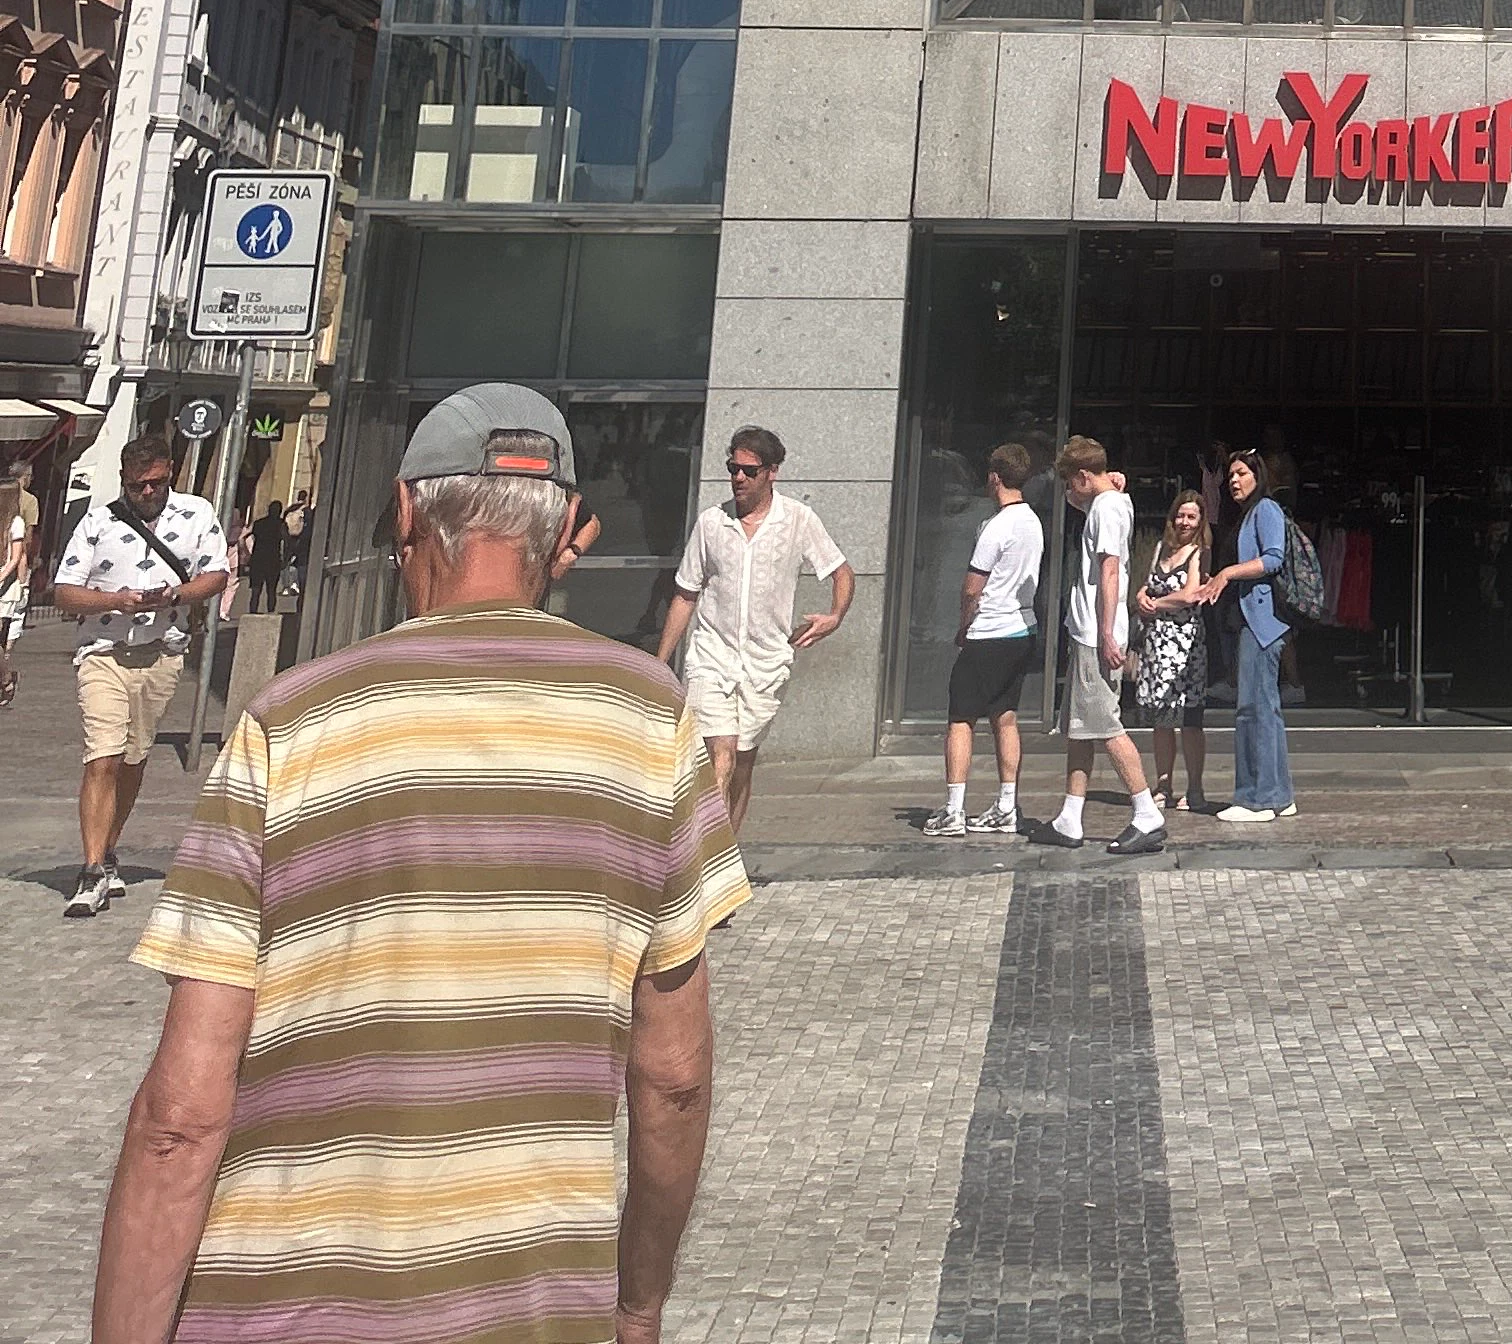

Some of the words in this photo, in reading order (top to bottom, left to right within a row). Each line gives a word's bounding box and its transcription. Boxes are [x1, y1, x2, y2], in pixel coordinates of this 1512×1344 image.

[225, 182, 262, 200] PĚŠÍ
[268, 183, 312, 200] ZÓNA
[245, 292, 262, 303] IZS
[240, 305, 252, 314] SE
[253, 305, 307, 315] SOUHLASEM
